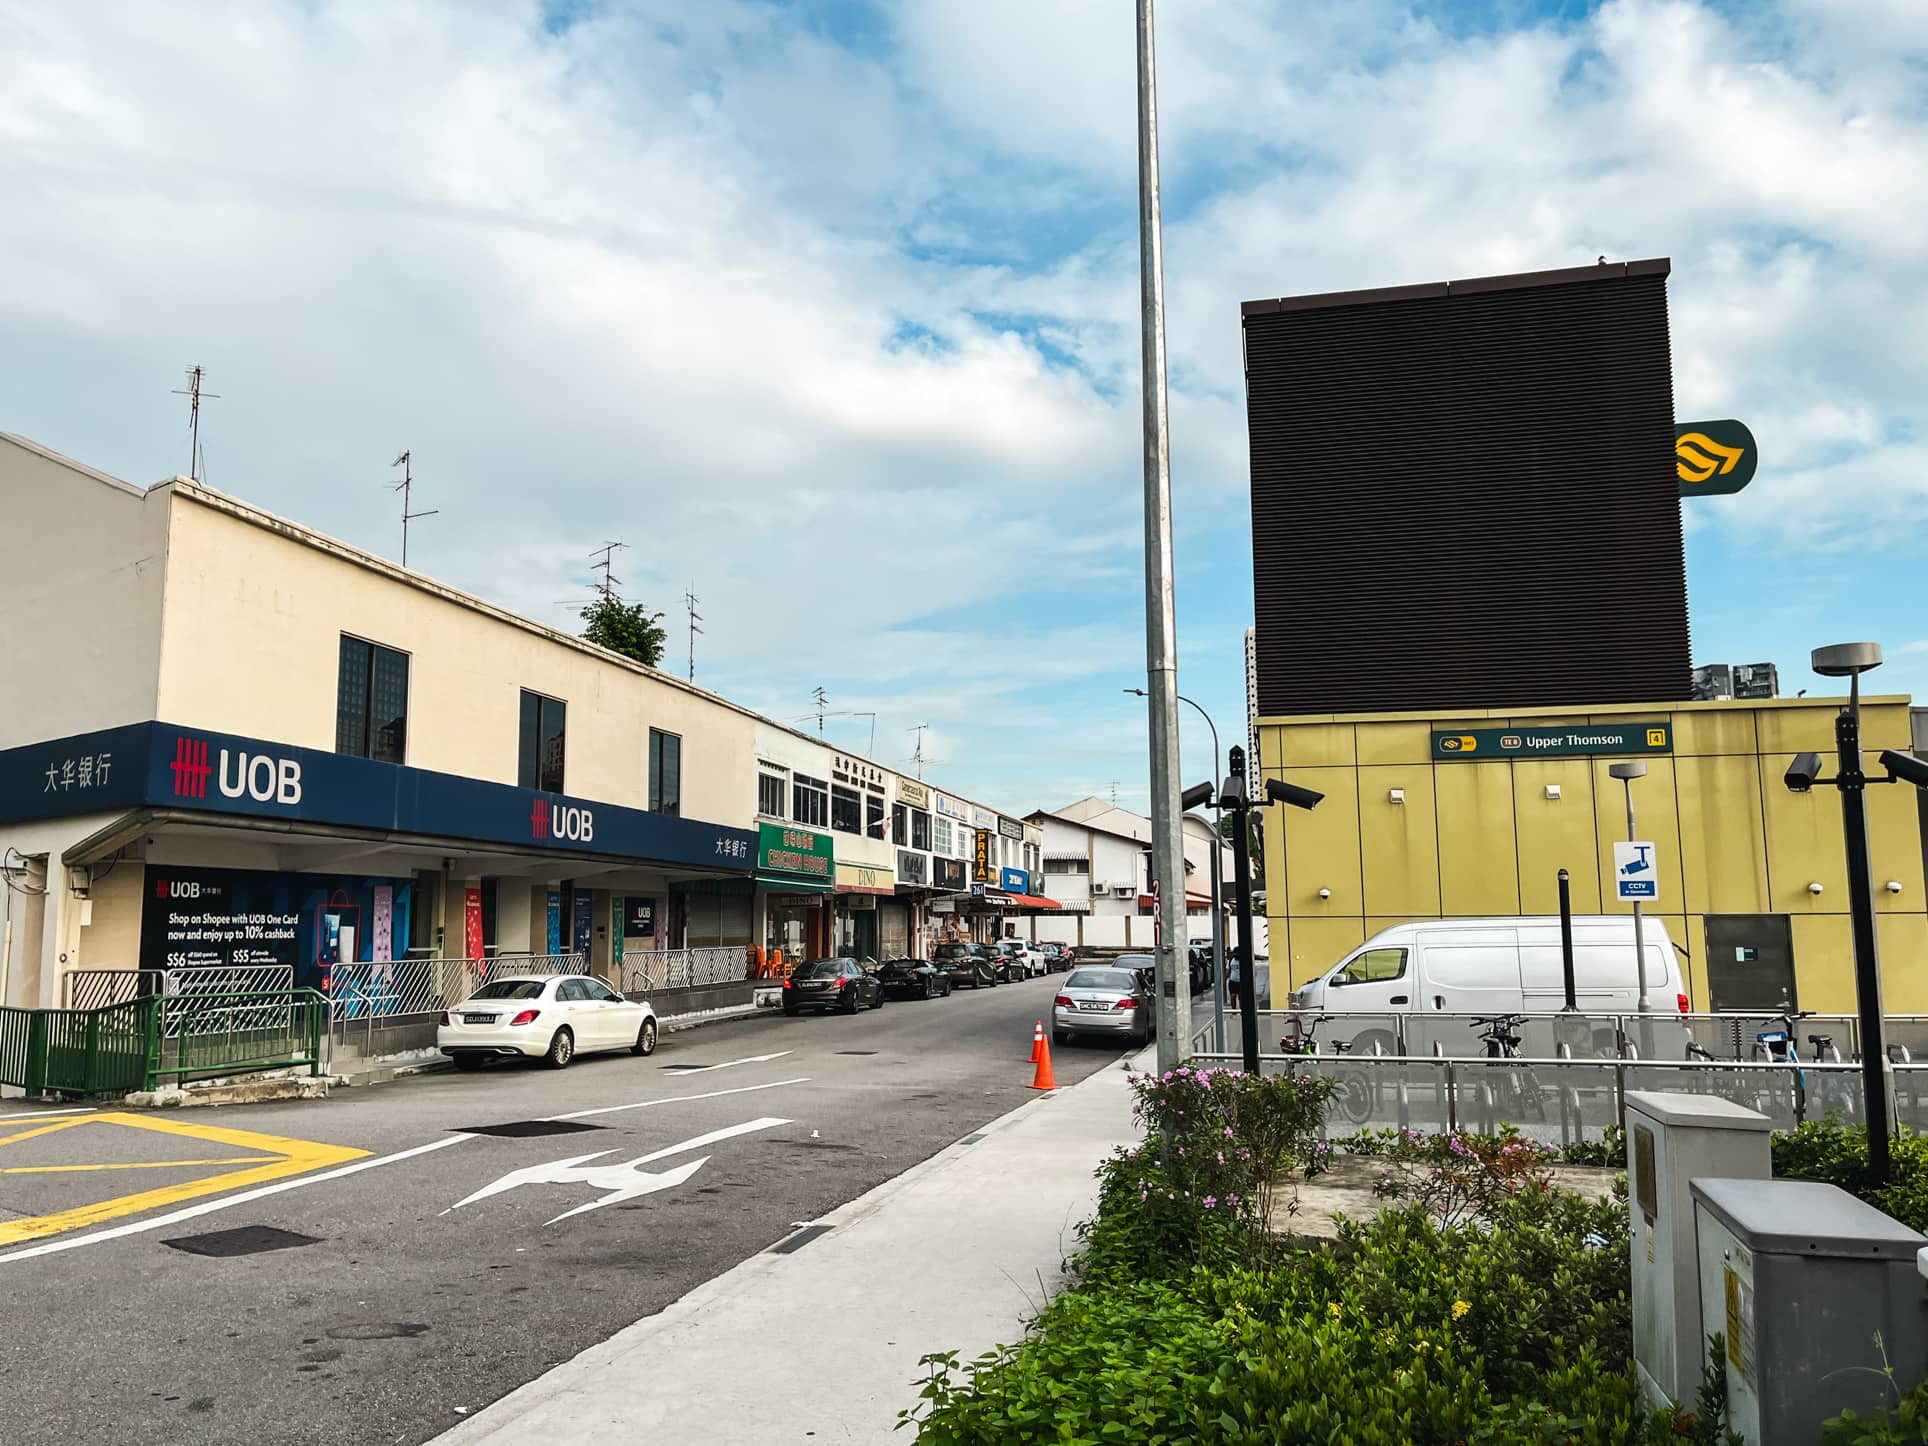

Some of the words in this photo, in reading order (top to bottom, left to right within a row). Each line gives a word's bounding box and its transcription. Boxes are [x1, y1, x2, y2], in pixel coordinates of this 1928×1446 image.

[1526, 736, 1563, 749] Upper
[1566, 734, 1623, 746] Thomson
[1653, 735, 1660, 743] 4
[44, 752, 112, 793] 大华银行
[218, 749, 302, 805] UOB
[552, 804, 594, 842] UOB
[715, 837, 748, 859] 大华银行
[977, 833, 986, 876] PRATA
[768, 849, 802, 870] CHICKEN
[803, 854, 828, 874] HOUSE
[858, 869, 876, 886] DINO
[170, 881, 200, 898] UOB
[168, 912, 190, 927] Shop
[191, 915, 201, 924] on
[202, 912, 231, 927] Shopee
[231, 913, 248, 924] with
[249, 914, 266, 924] UOB
[266, 914, 281, 925] One
[282, 913, 299, 925] Card
[638, 906, 651, 919] UOB
[167, 931, 186, 941] now
[186, 928, 202, 940] and
[202, 929, 223, 943] enjoy
[224, 931, 234, 943] up
[235, 931, 244, 940] to
[245, 926, 264, 940] 10%
[264, 928, 296, 940] cashback
[167, 952, 186, 968] S$6
[233, 949, 250, 963] S$5
